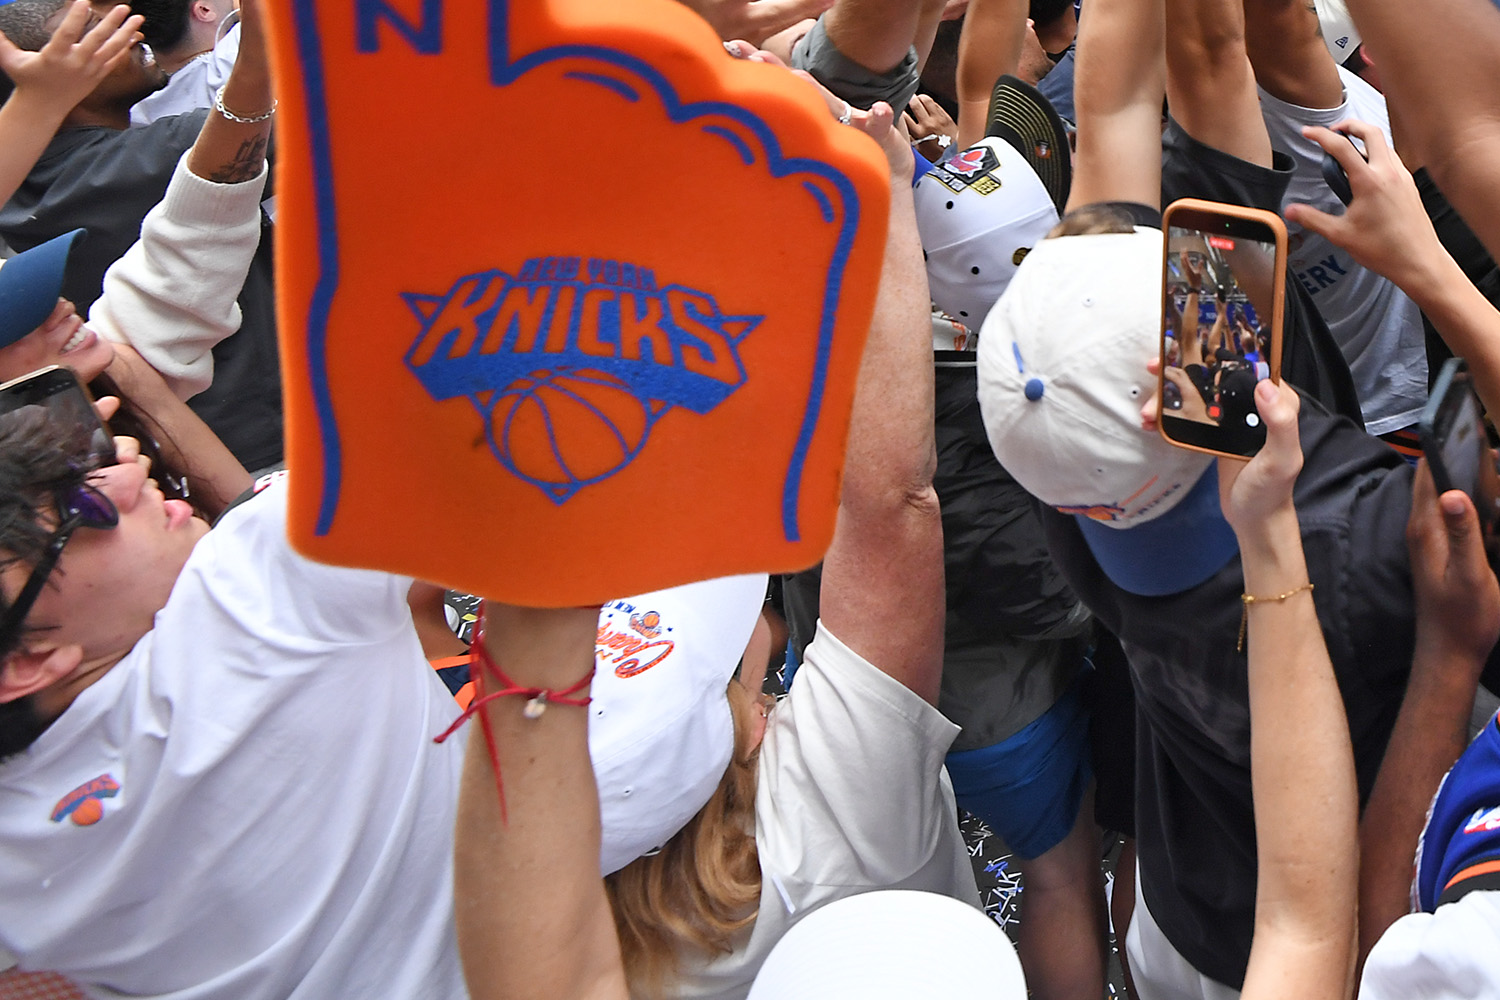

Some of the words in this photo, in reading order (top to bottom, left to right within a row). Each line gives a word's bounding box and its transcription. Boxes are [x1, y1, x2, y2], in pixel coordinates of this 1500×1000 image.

[516, 256, 582, 282] NEW
[587, 257, 658, 292] YORK
[409, 276, 743, 387] KNICKS
